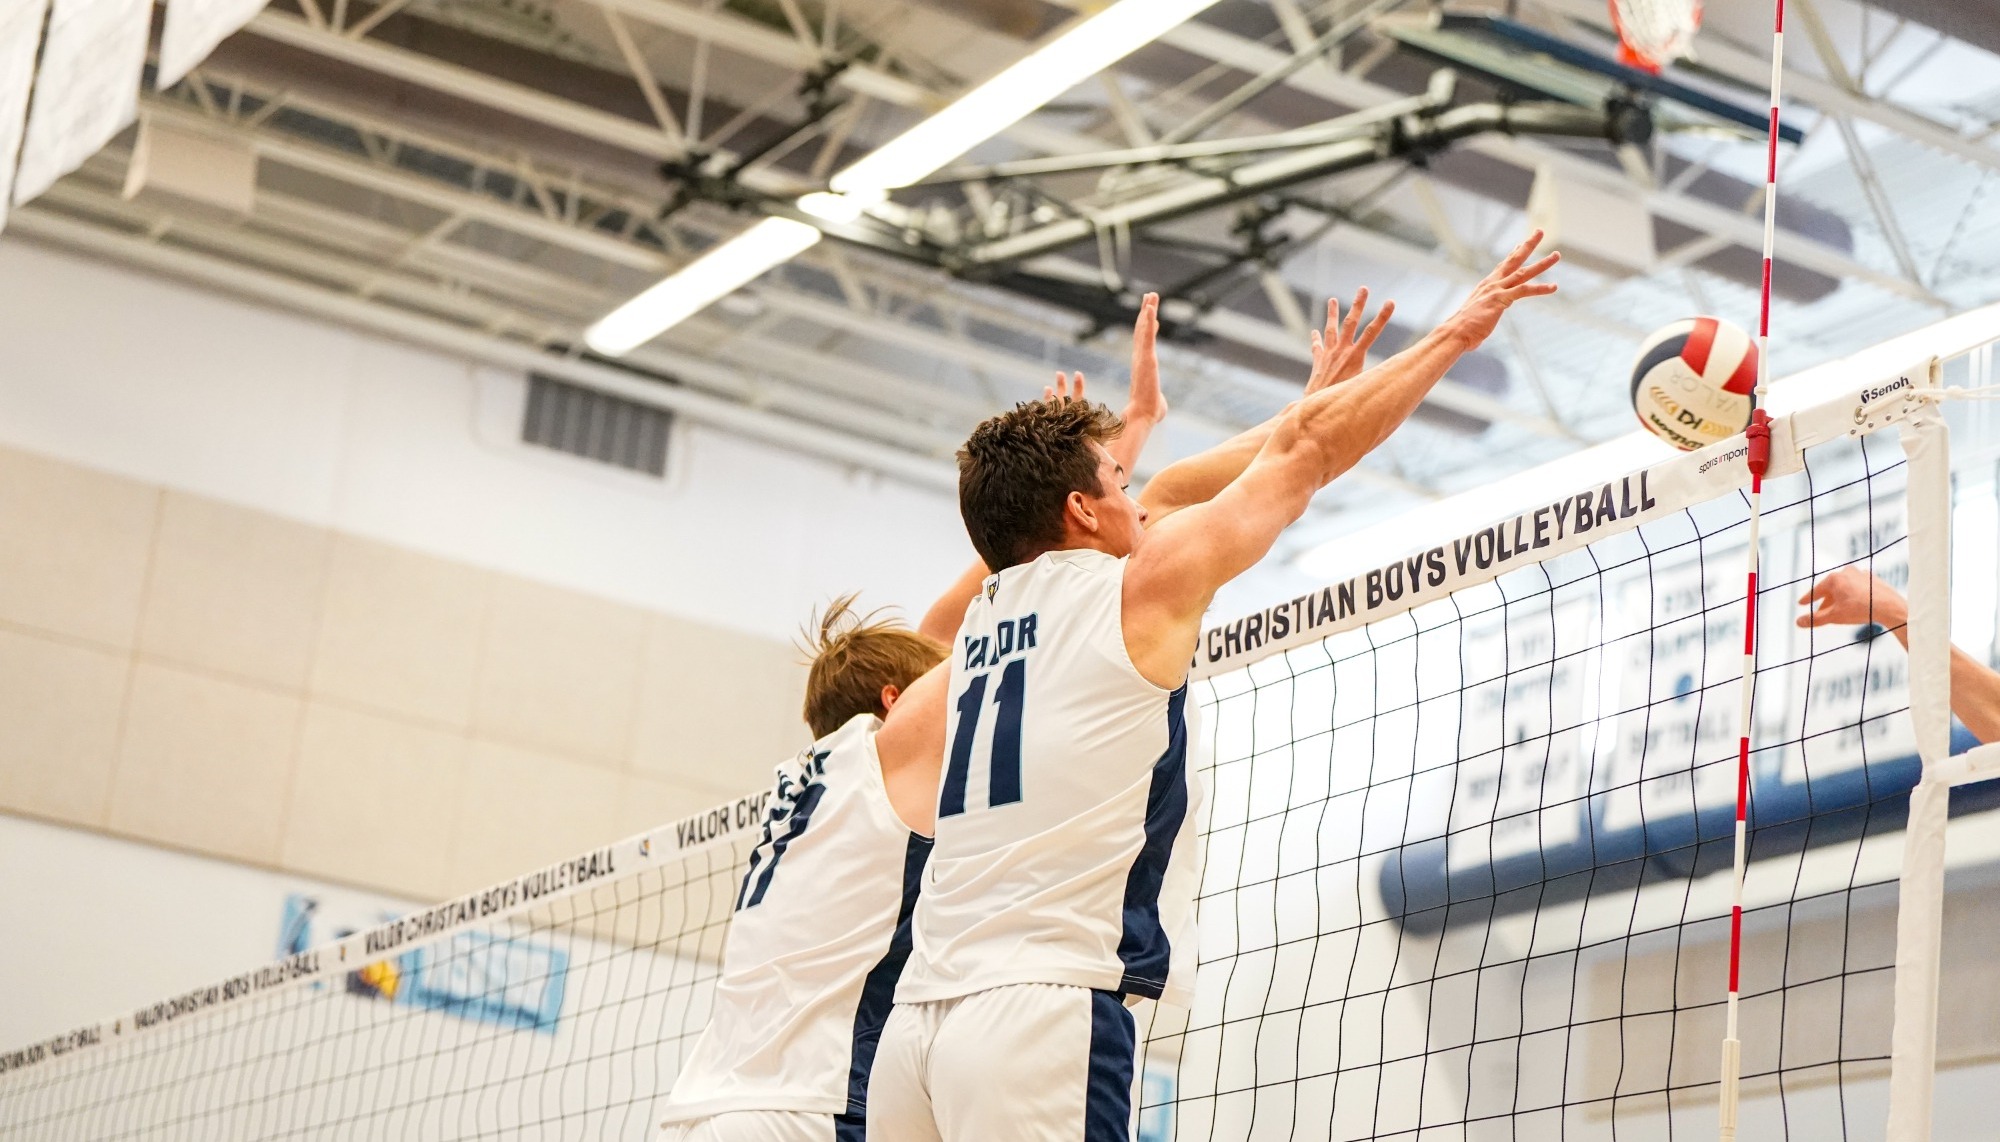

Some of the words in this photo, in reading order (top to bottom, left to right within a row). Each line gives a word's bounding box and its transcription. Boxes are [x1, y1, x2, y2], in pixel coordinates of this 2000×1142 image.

[1871, 376, 1910, 399] Senoh
[1207, 578, 1356, 662] CHRISTIAN
[1366, 546, 1446, 609] BOYS
[1453, 469, 1656, 576] VOLLEYBALL
[938, 656, 1027, 820] 11
[676, 806, 729, 849] VALOR
[365, 920, 404, 955] VALOR
[406, 896, 477, 943] CHRISTIAN
[480, 881, 518, 917] BOYS
[521, 848, 615, 902] VOLLEYBALL
